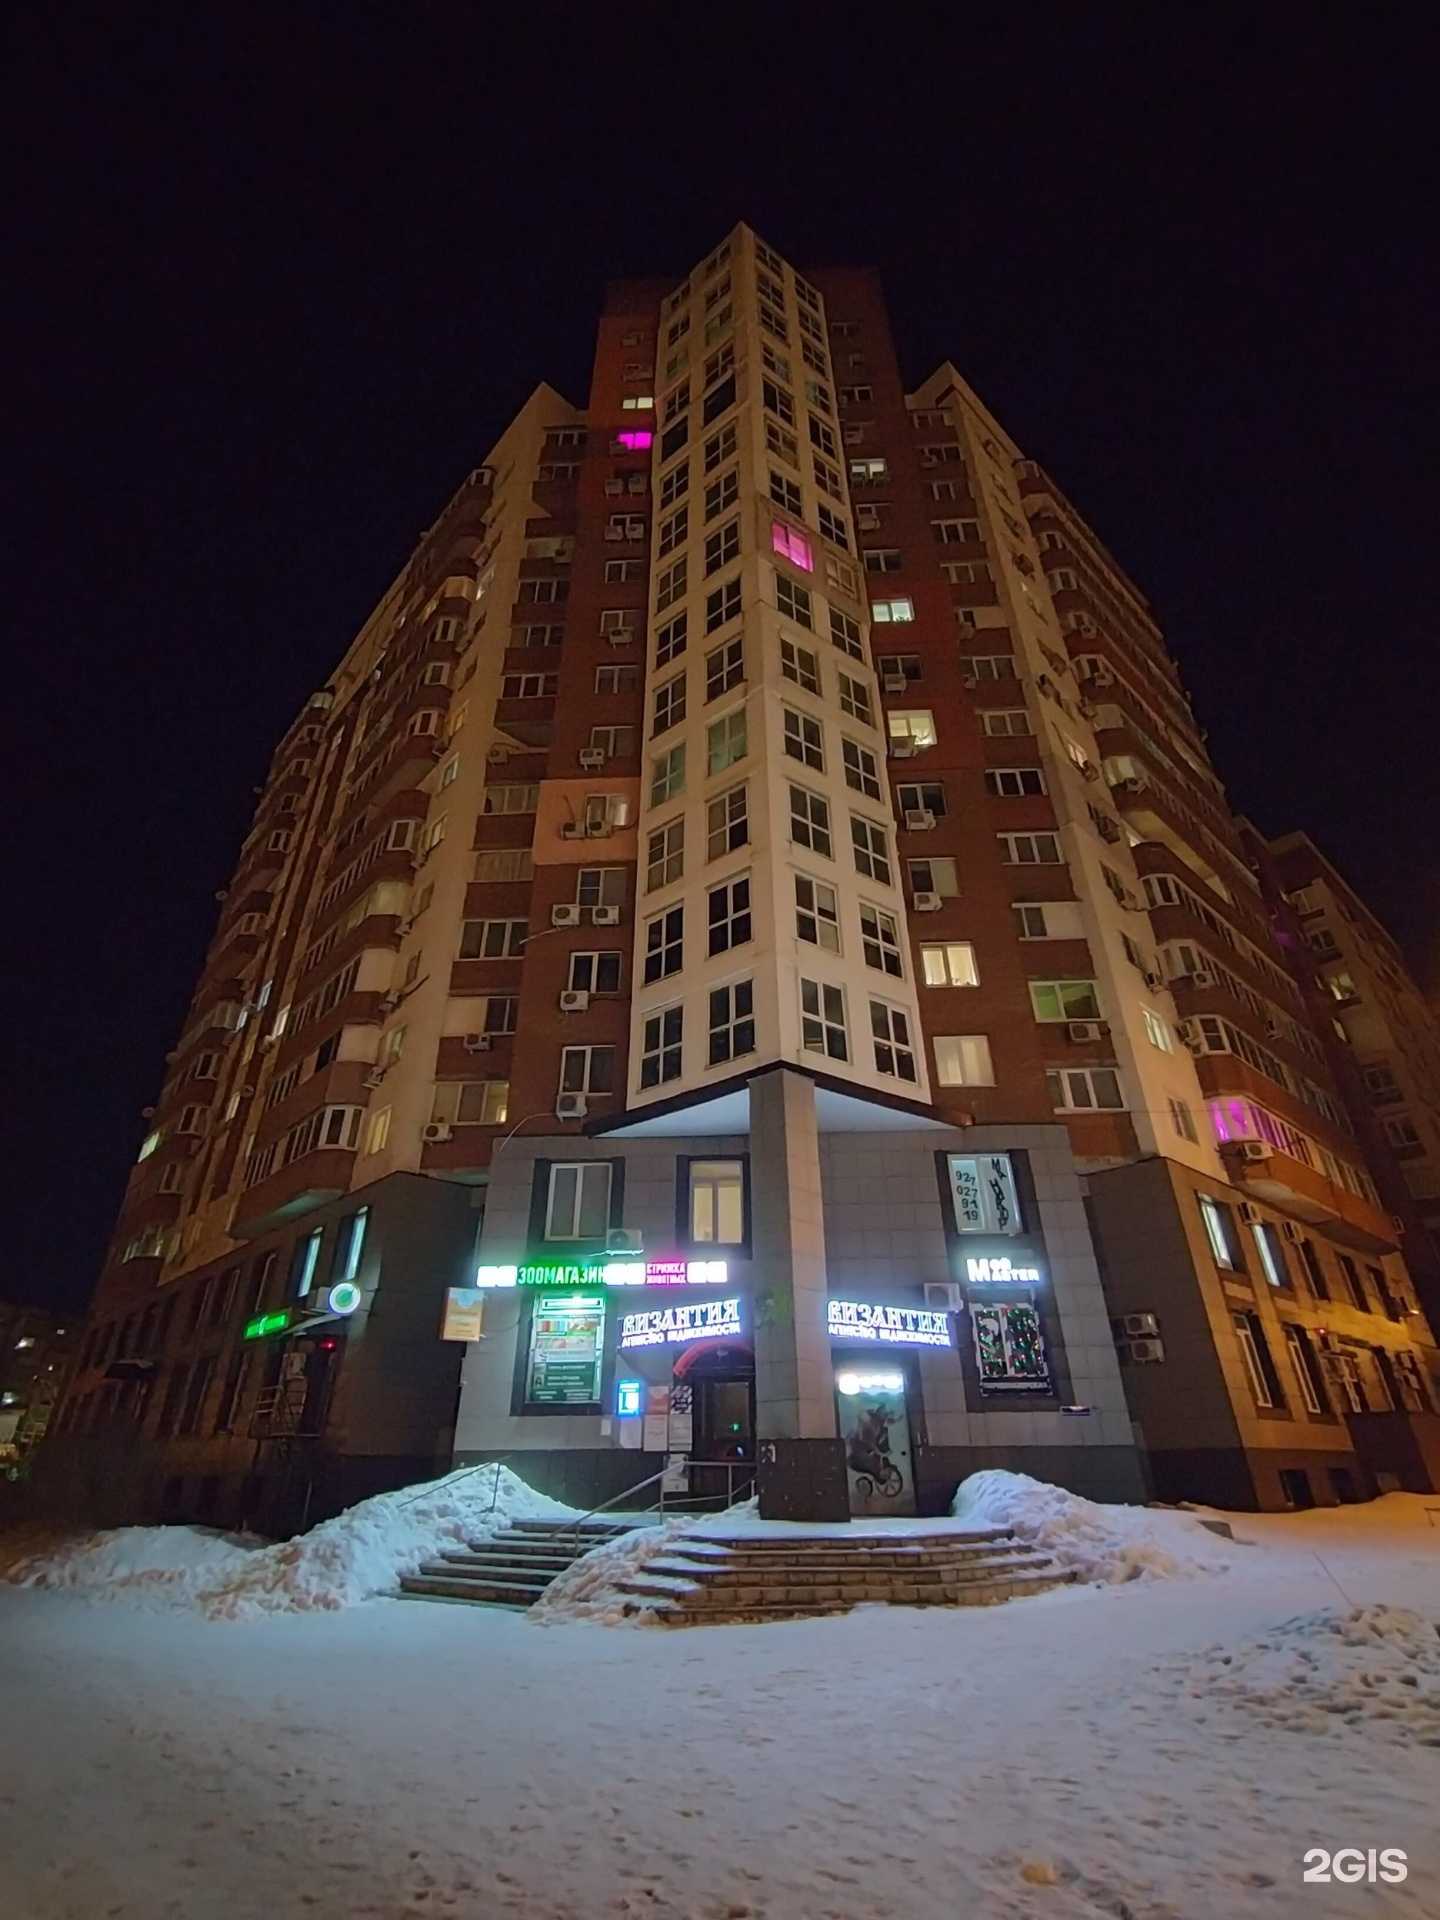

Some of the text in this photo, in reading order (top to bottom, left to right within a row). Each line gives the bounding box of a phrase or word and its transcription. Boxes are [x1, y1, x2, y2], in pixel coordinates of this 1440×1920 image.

[955, 1170, 977, 1186] 927
[956, 1185, 979, 1199] 027
[962, 1209, 979, 1221] 19
[518, 1265, 605, 1285] ЗООМАГАЗИН
[647, 1263, 685, 1274] СТРИЖКА
[622, 1299, 740, 1336] ВИЗАНТИЯ
[828, 1300, 948, 1335] ВИЗАНТИЯ
